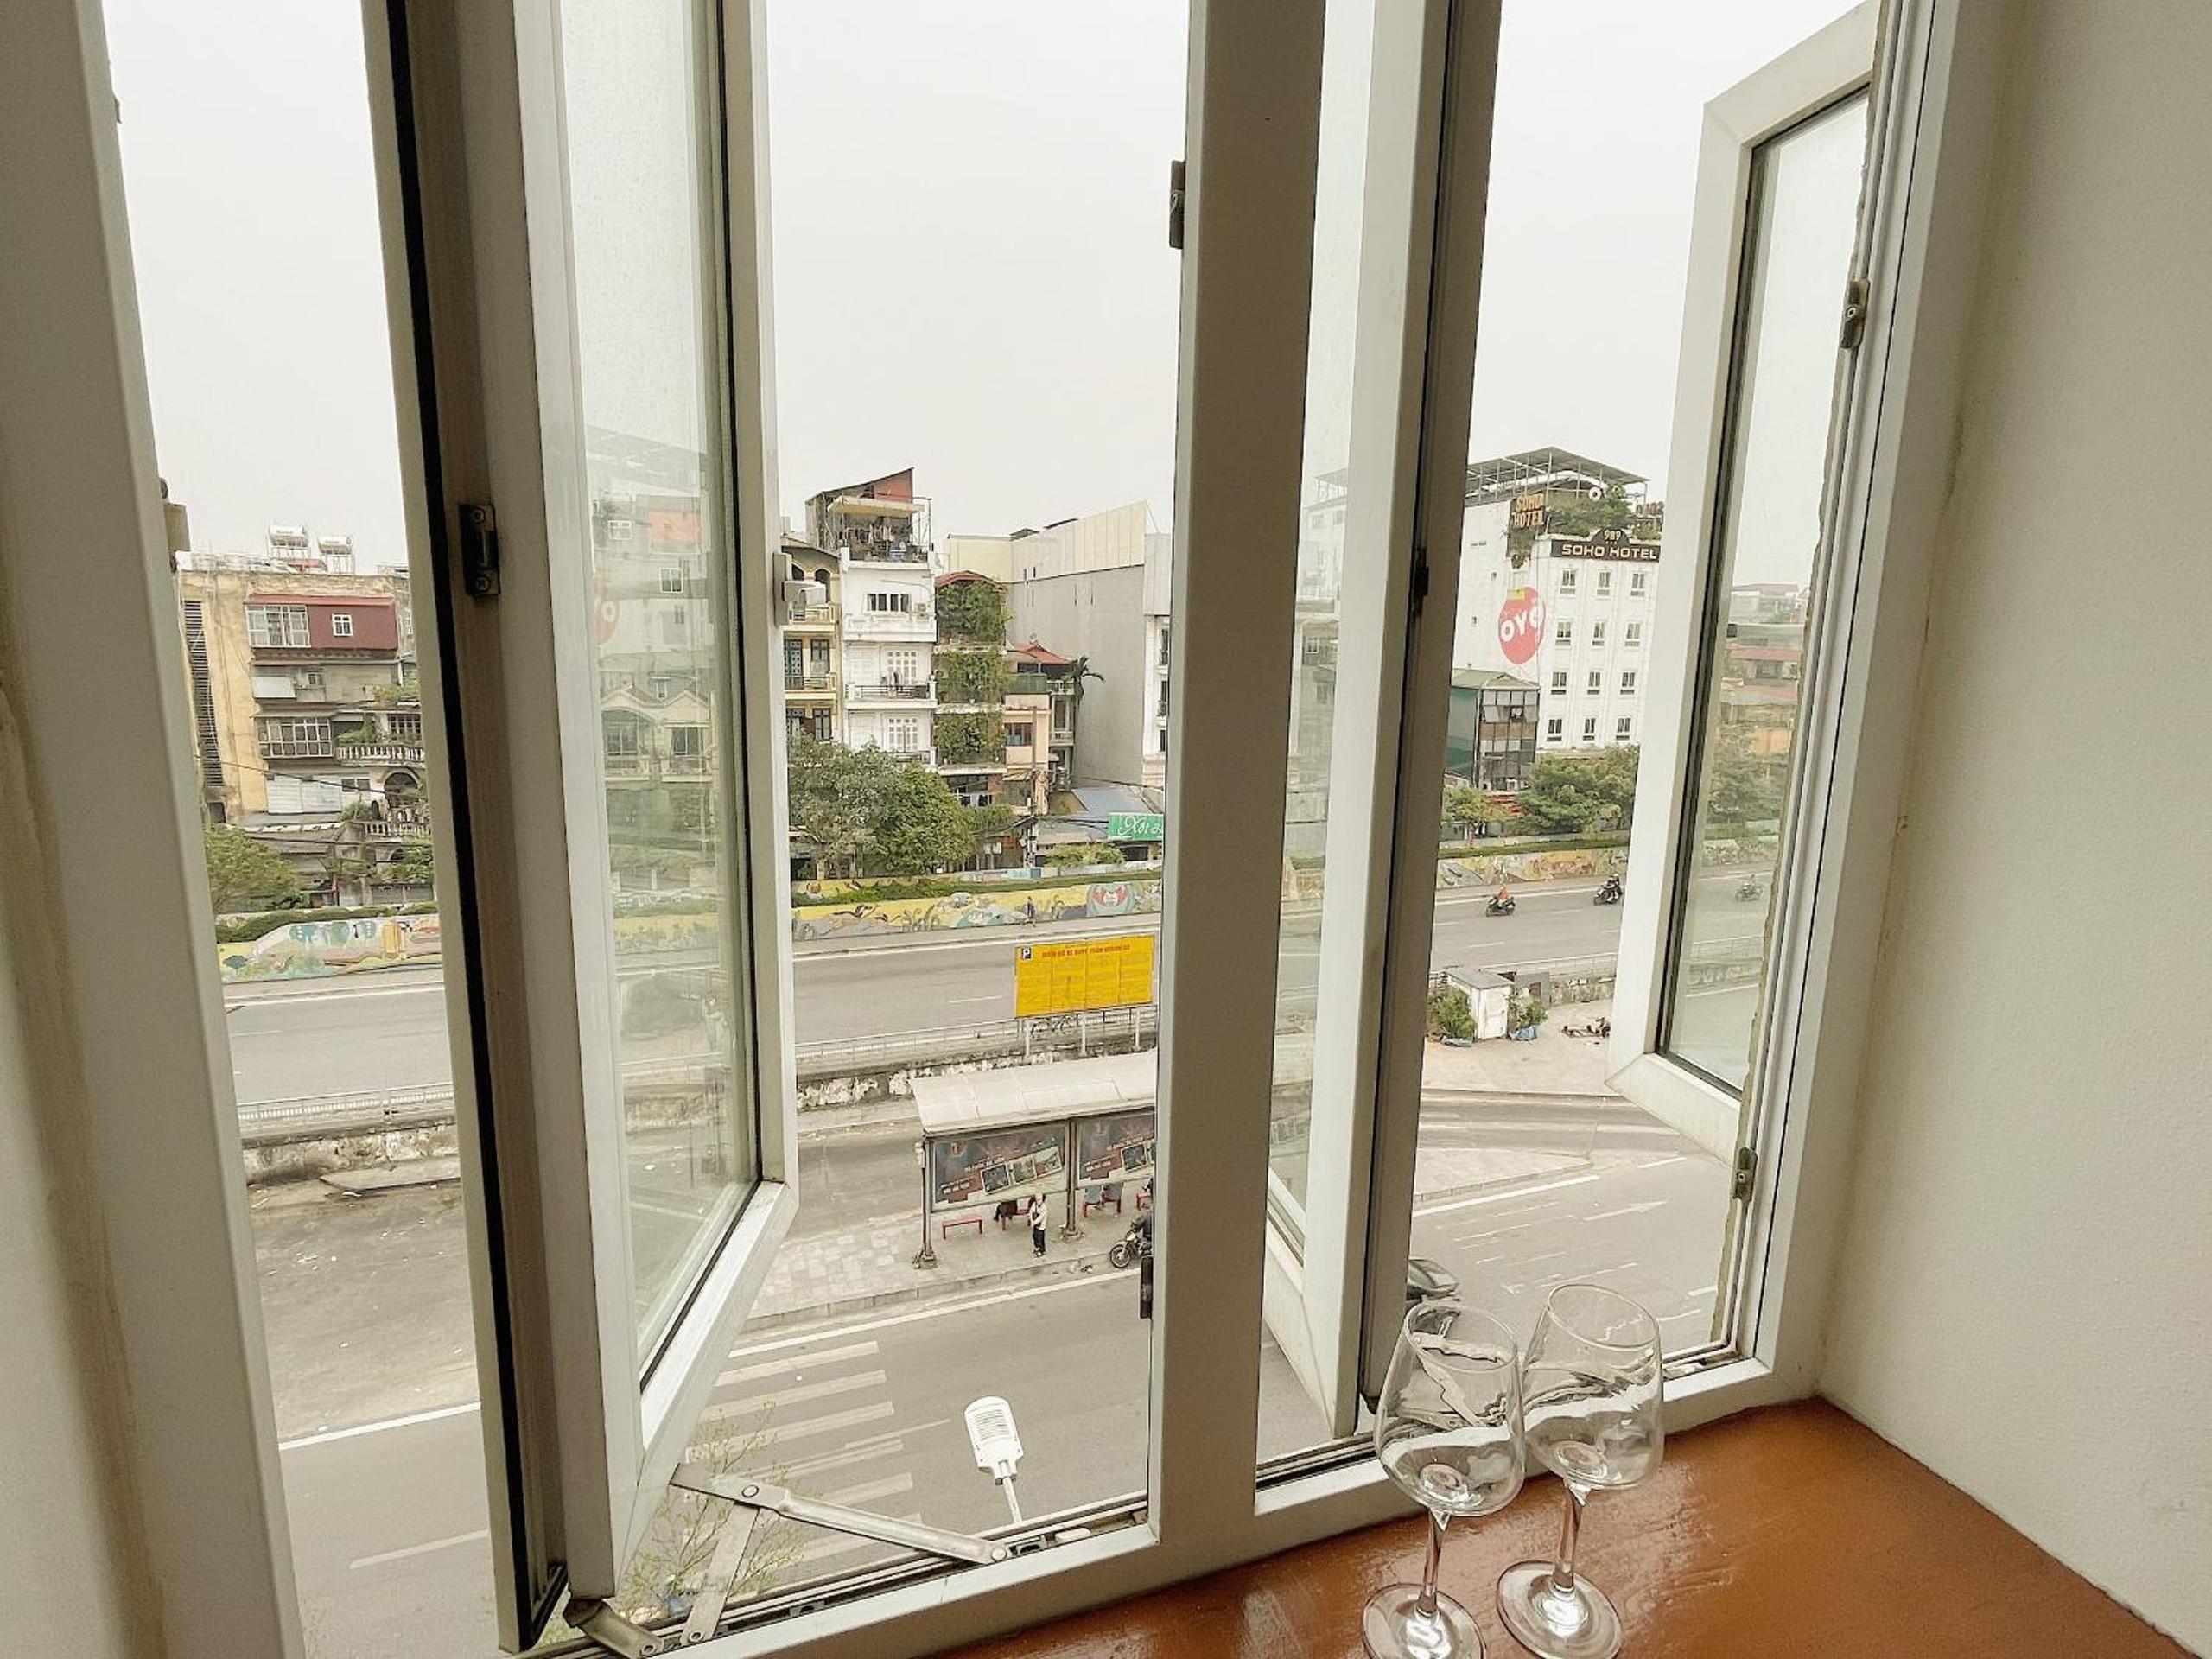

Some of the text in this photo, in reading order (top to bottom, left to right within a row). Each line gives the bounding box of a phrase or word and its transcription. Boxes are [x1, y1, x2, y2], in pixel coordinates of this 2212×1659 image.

[1512, 511, 1544, 527] HOTEL
[1605, 530, 1621, 540] 989
[1561, 544, 1657, 560] SOHO HOTEL
[1501, 605, 1542, 642] OYO
